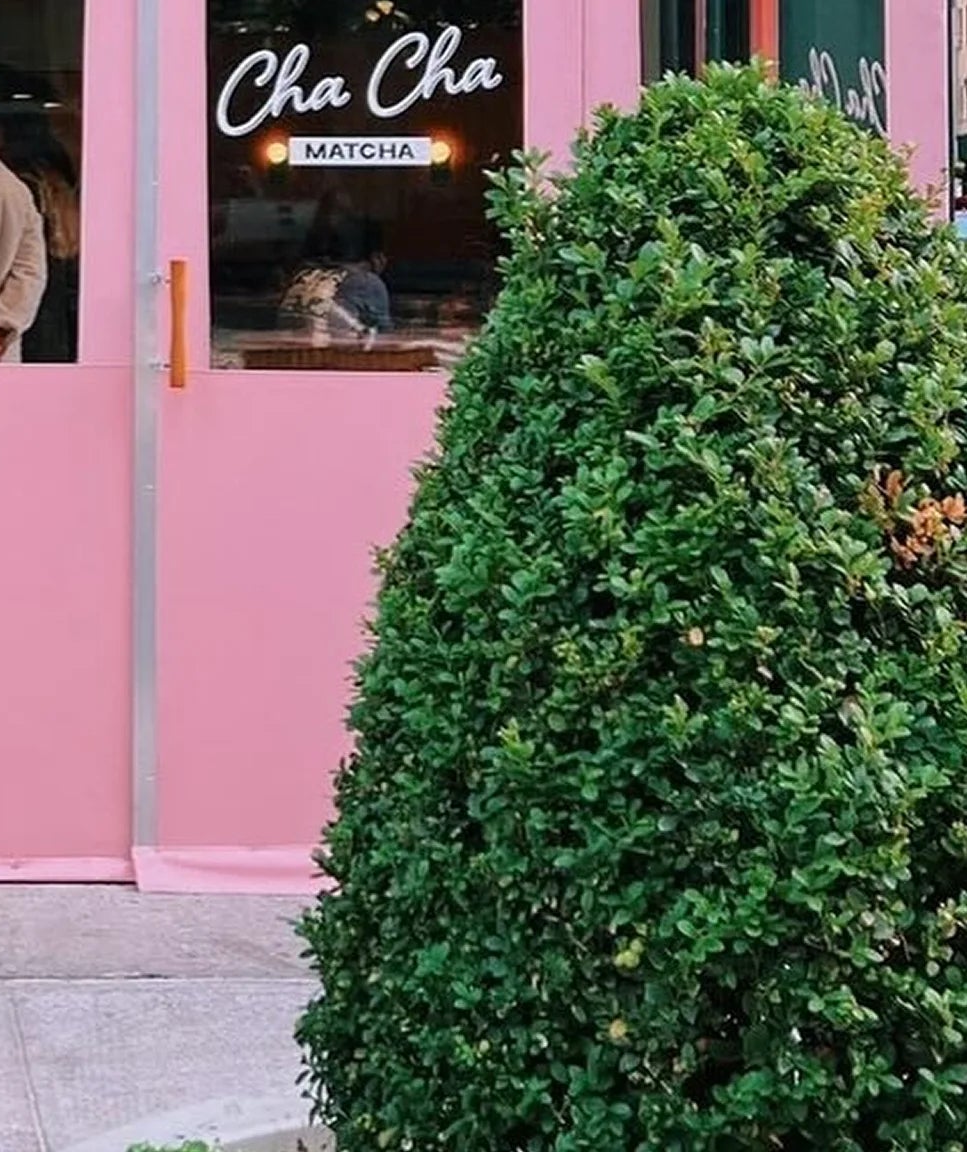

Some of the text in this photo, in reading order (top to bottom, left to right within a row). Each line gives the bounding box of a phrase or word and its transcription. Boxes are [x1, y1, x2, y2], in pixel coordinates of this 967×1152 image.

[216, 24, 503, 136] Cha Cha
[305, 143, 415, 160] MATCHA
